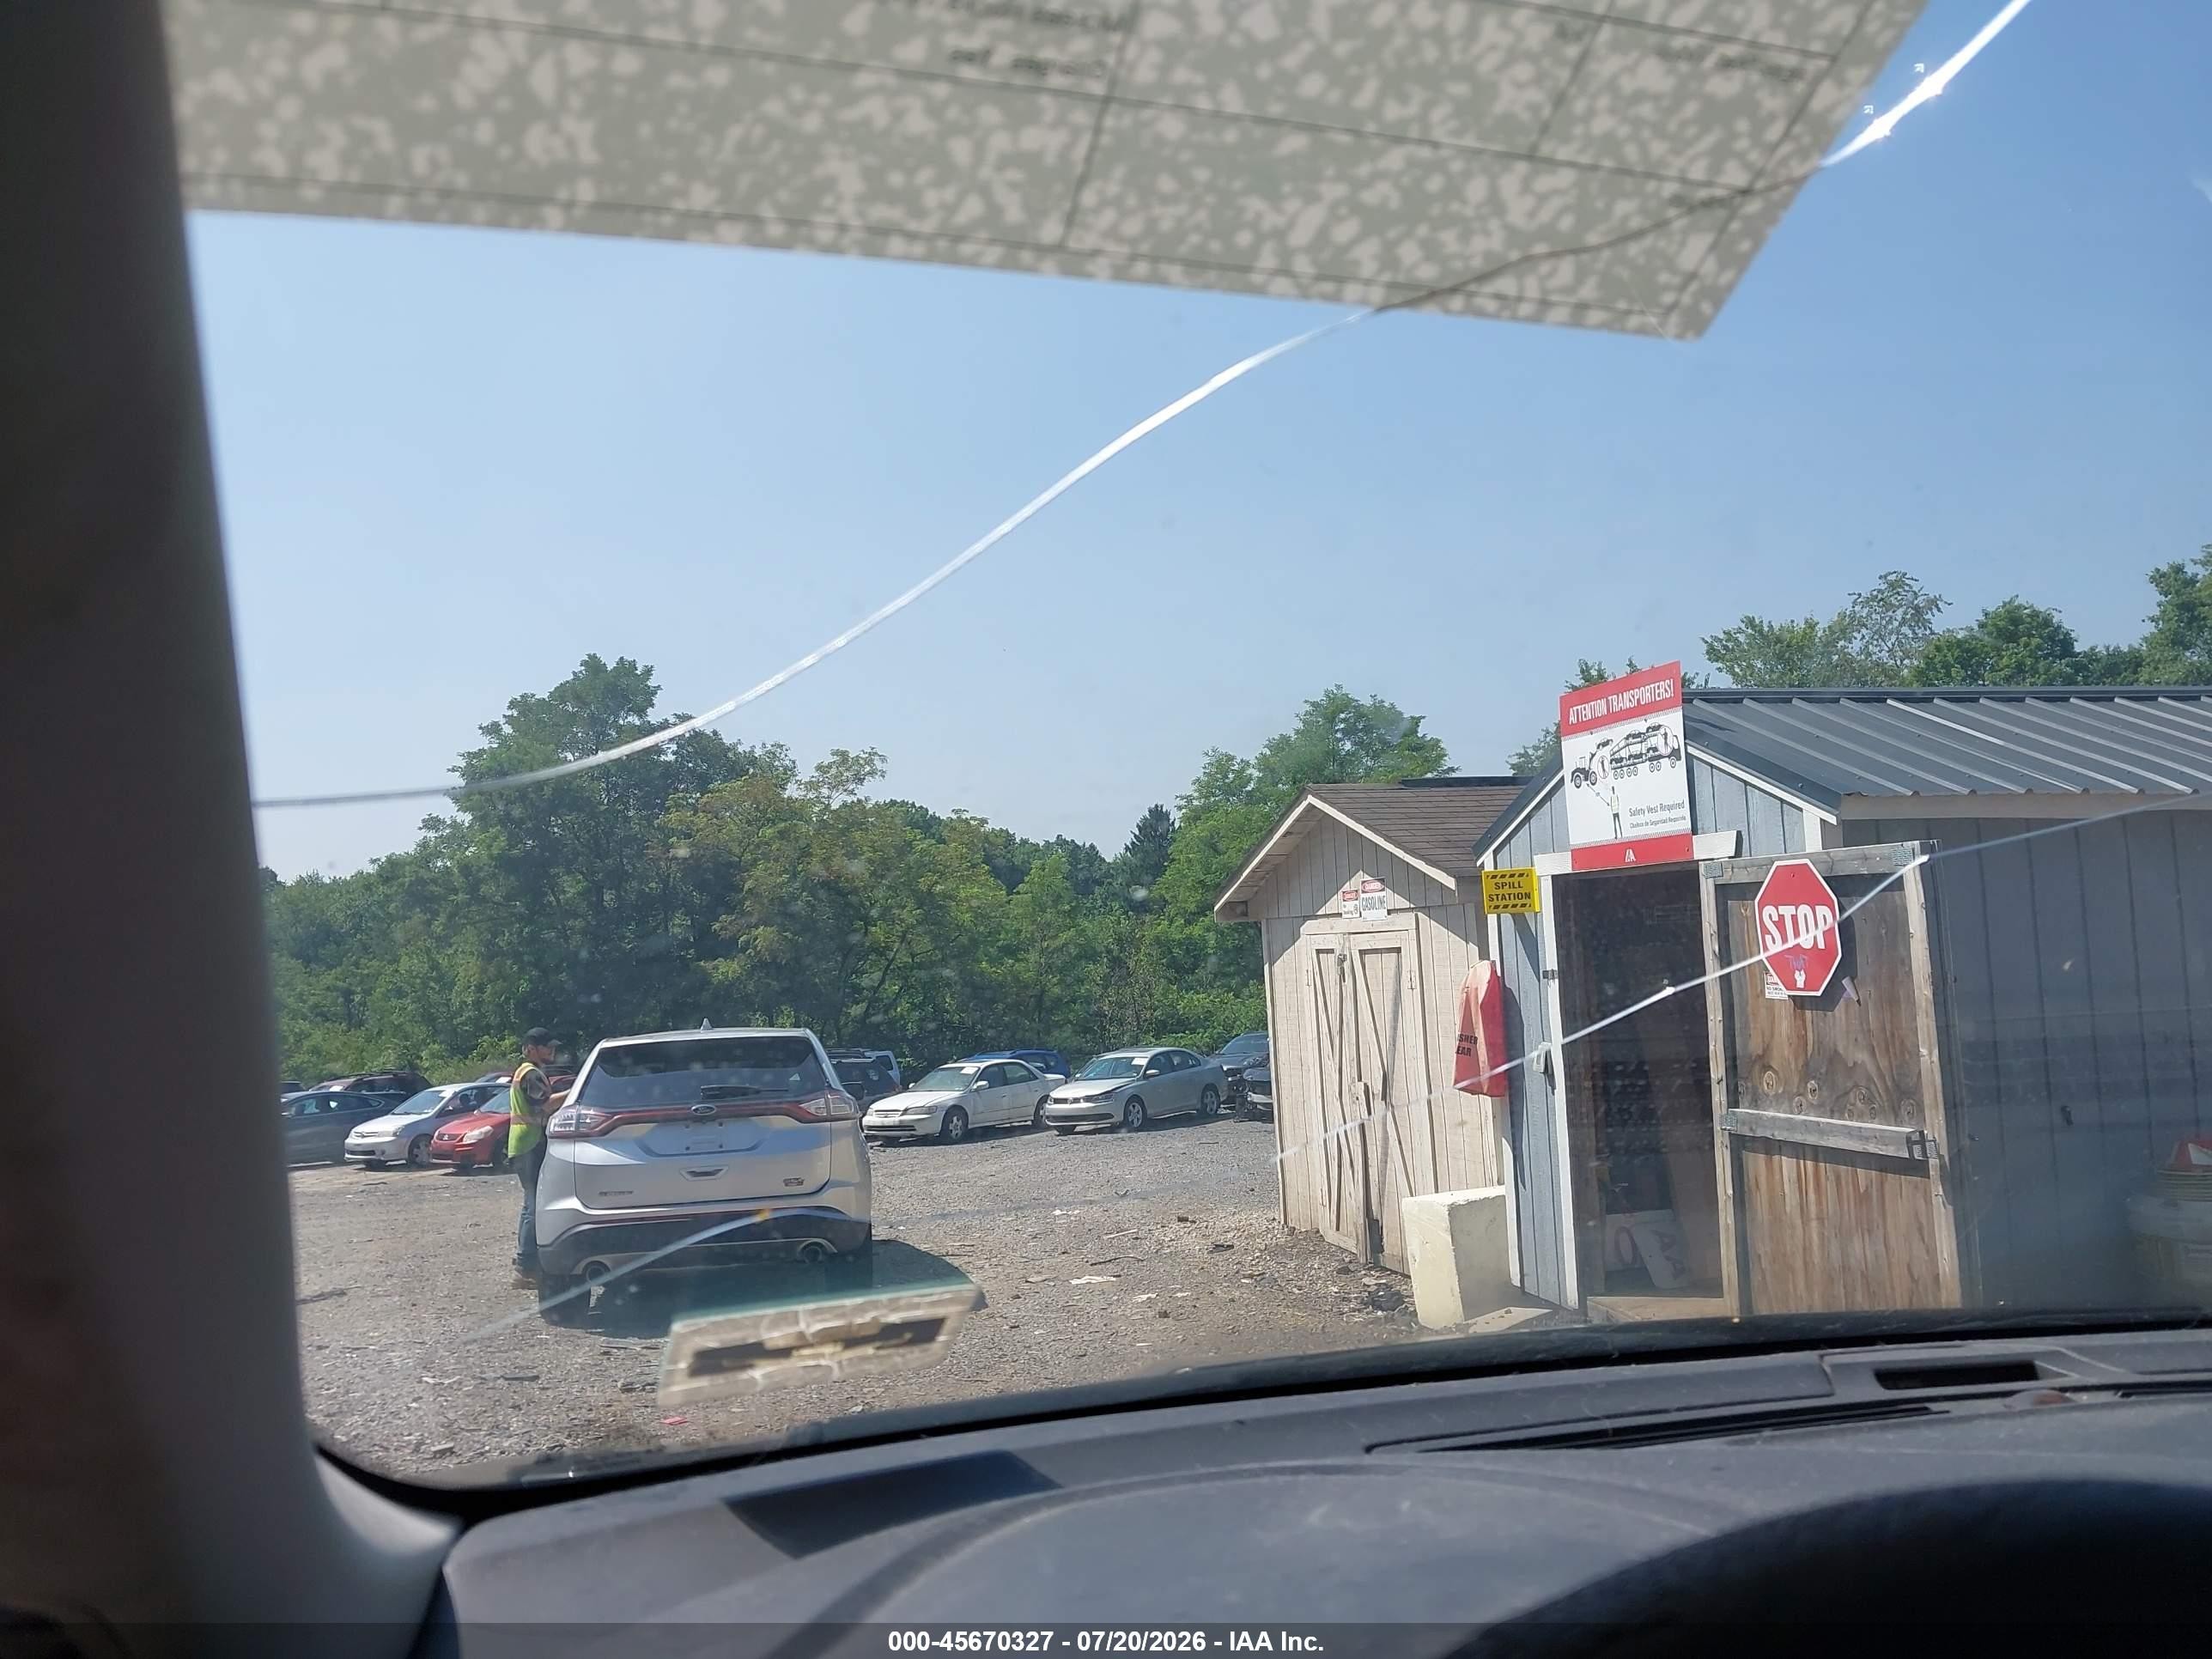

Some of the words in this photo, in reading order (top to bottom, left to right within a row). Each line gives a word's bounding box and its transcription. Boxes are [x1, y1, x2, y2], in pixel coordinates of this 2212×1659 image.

[1569, 697, 1607, 725] ATTENTION
[1608, 678, 1674, 713] TRANSPORTERS!
[1628, 806, 1645, 817] Safety
[1646, 805, 1658, 814] Vest
[1659, 799, 1685, 813] Required
[1494, 880, 1524, 890] SPILL
[1361, 895, 1387, 911] GASOLINE
[1487, 891, 1531, 902] STATION
[1763, 904, 1833, 951] STOP
